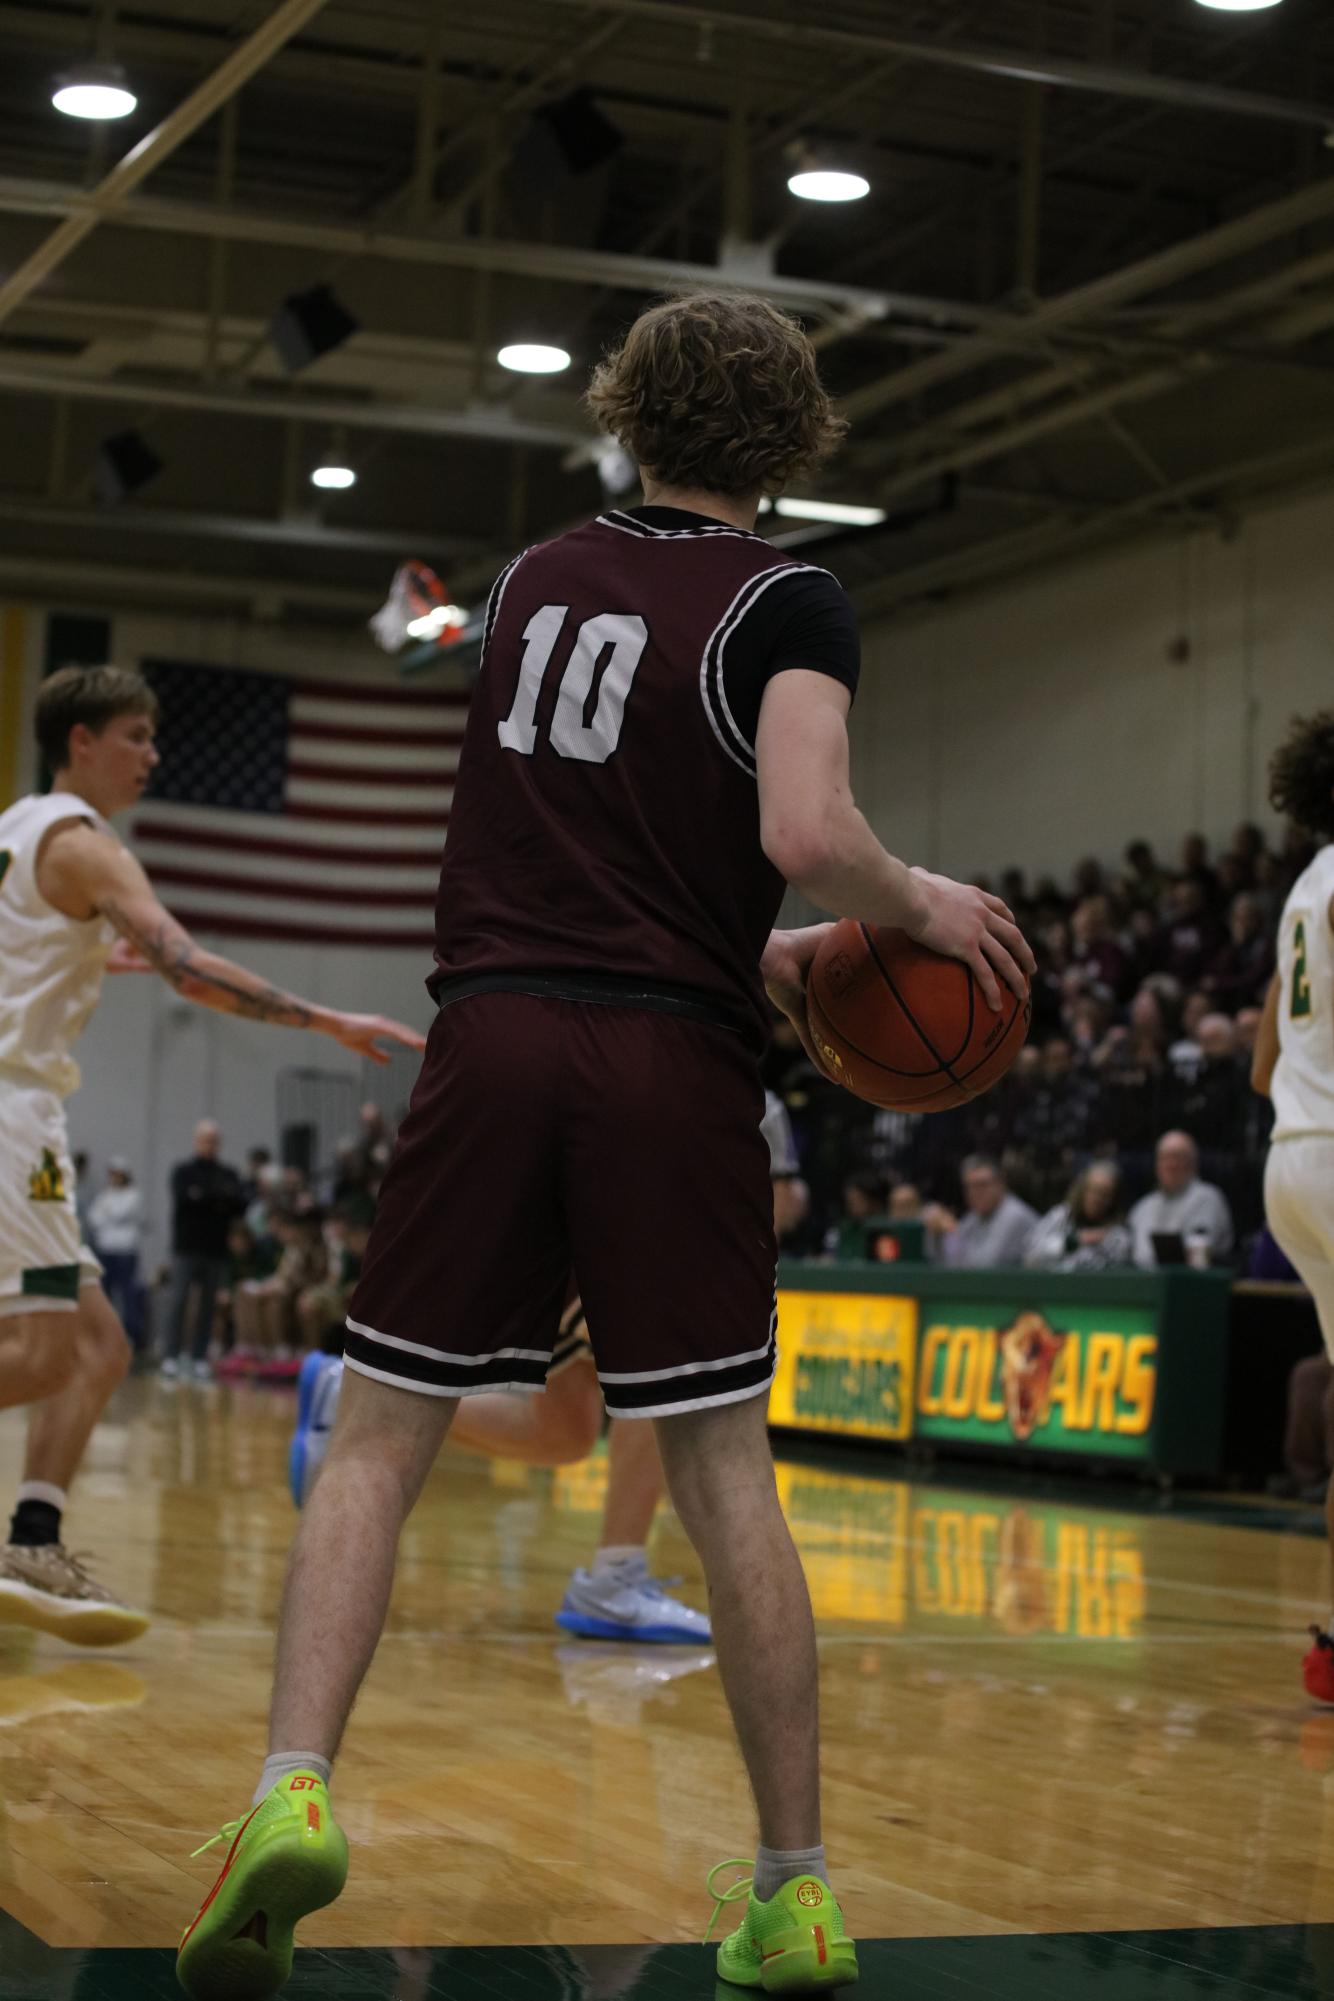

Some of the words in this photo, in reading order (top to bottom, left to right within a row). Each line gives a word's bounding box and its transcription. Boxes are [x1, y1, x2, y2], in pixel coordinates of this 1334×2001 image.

[497, 604, 650, 765] 10
[1289, 918, 1312, 1019] 2
[290, 1776, 321, 1790] GT
[801, 1889, 820, 1897] EYBL
